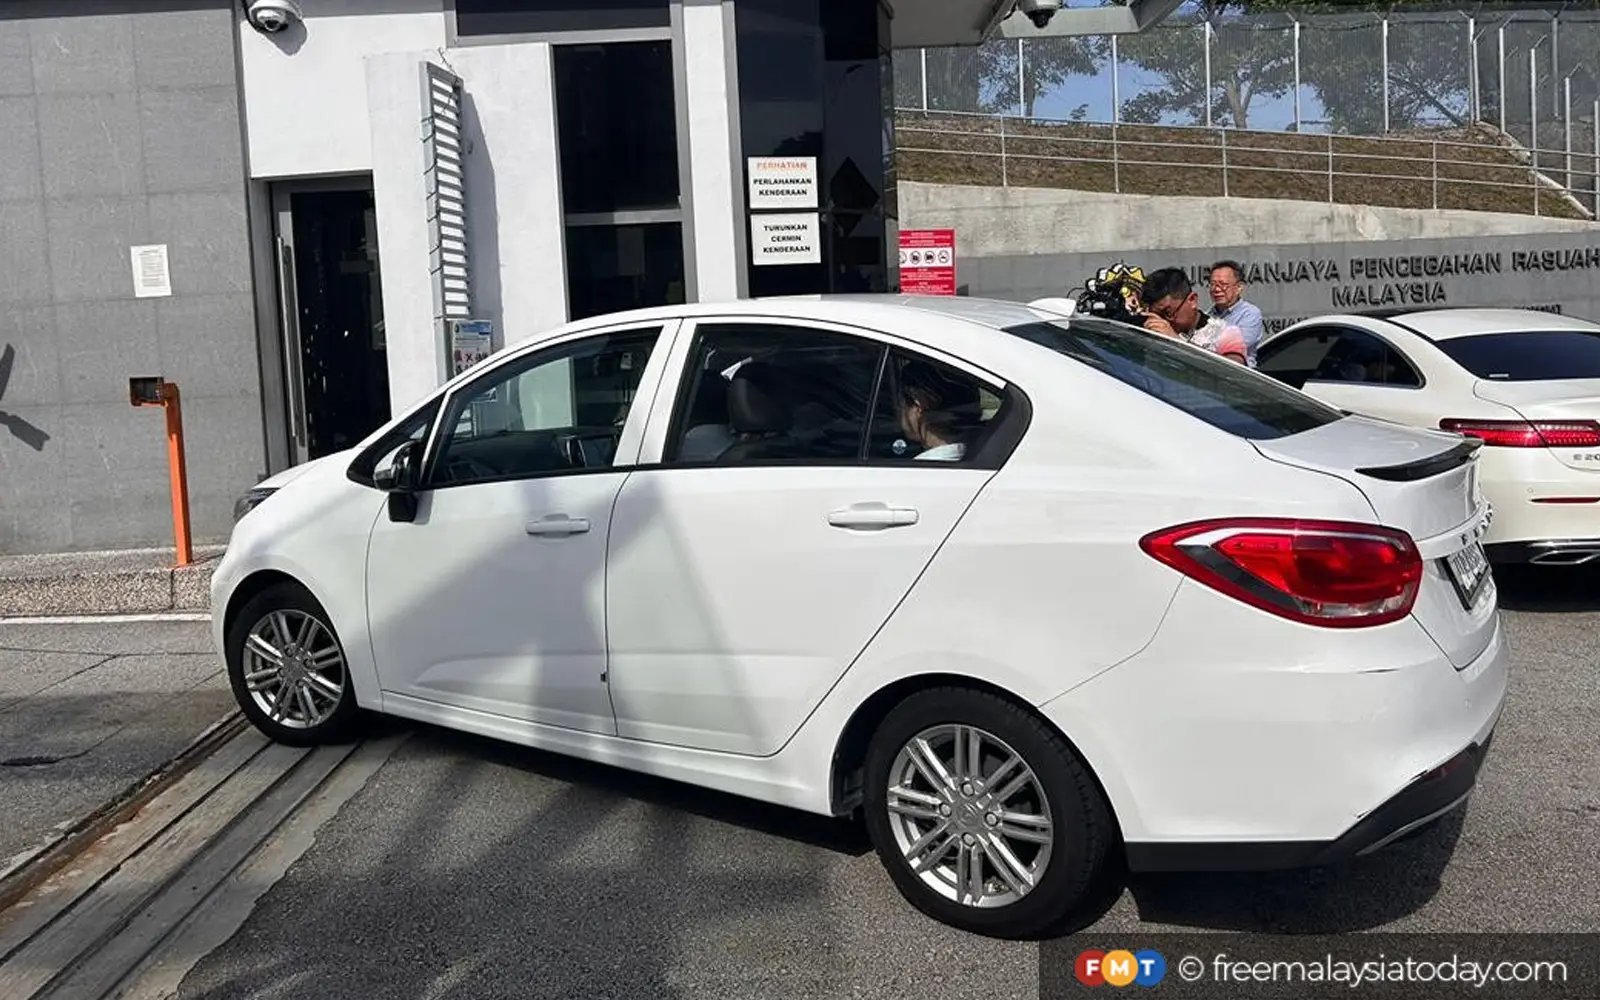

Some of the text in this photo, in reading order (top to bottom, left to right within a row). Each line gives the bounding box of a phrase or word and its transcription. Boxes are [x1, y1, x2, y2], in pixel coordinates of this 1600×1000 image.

[756, 161, 807, 170] PERHATIAN
[753, 177, 812, 185] PERLAHANKAN
[1350, 252, 1501, 280] PENCEGAHAN
[1511, 247, 1600, 272] RASUAH
[1331, 281, 1447, 308] MALAYSIA
